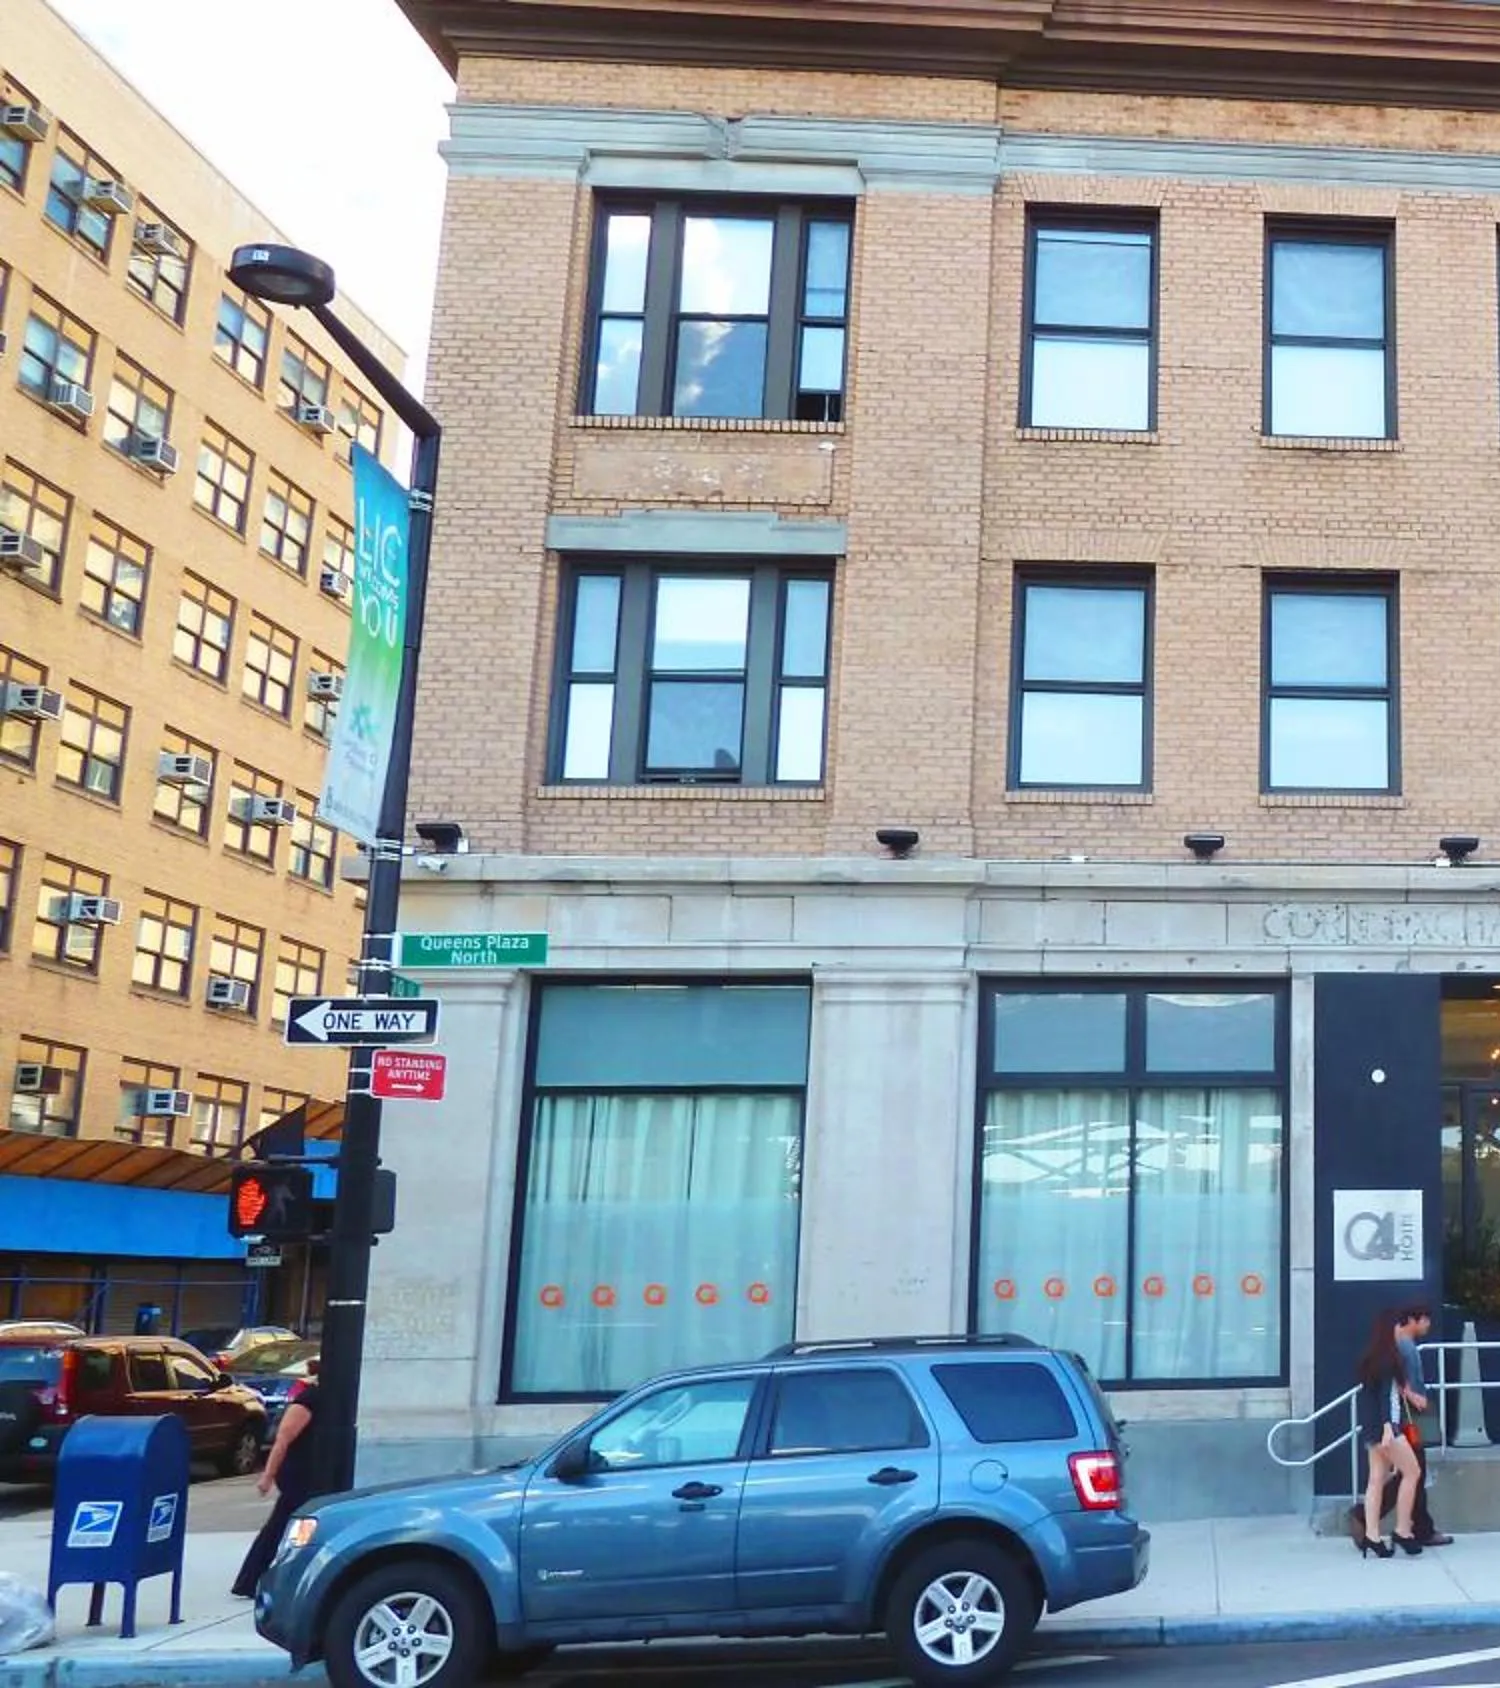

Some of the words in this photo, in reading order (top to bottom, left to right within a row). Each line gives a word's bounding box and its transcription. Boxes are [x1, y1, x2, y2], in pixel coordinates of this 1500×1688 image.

[359, 497, 402, 587] LIC
[358, 580, 398, 648] YOU
[420, 936, 481, 951] Queens
[486, 935, 529, 949] Plaza
[451, 950, 497, 964] North
[323, 1013, 362, 1030] ONE
[375, 1013, 415, 1030] WAY
[377, 1056, 393, 1067] NO
[394, 1057, 443, 1070] STANDING
[387, 1068, 431, 1081] ANYTIME
